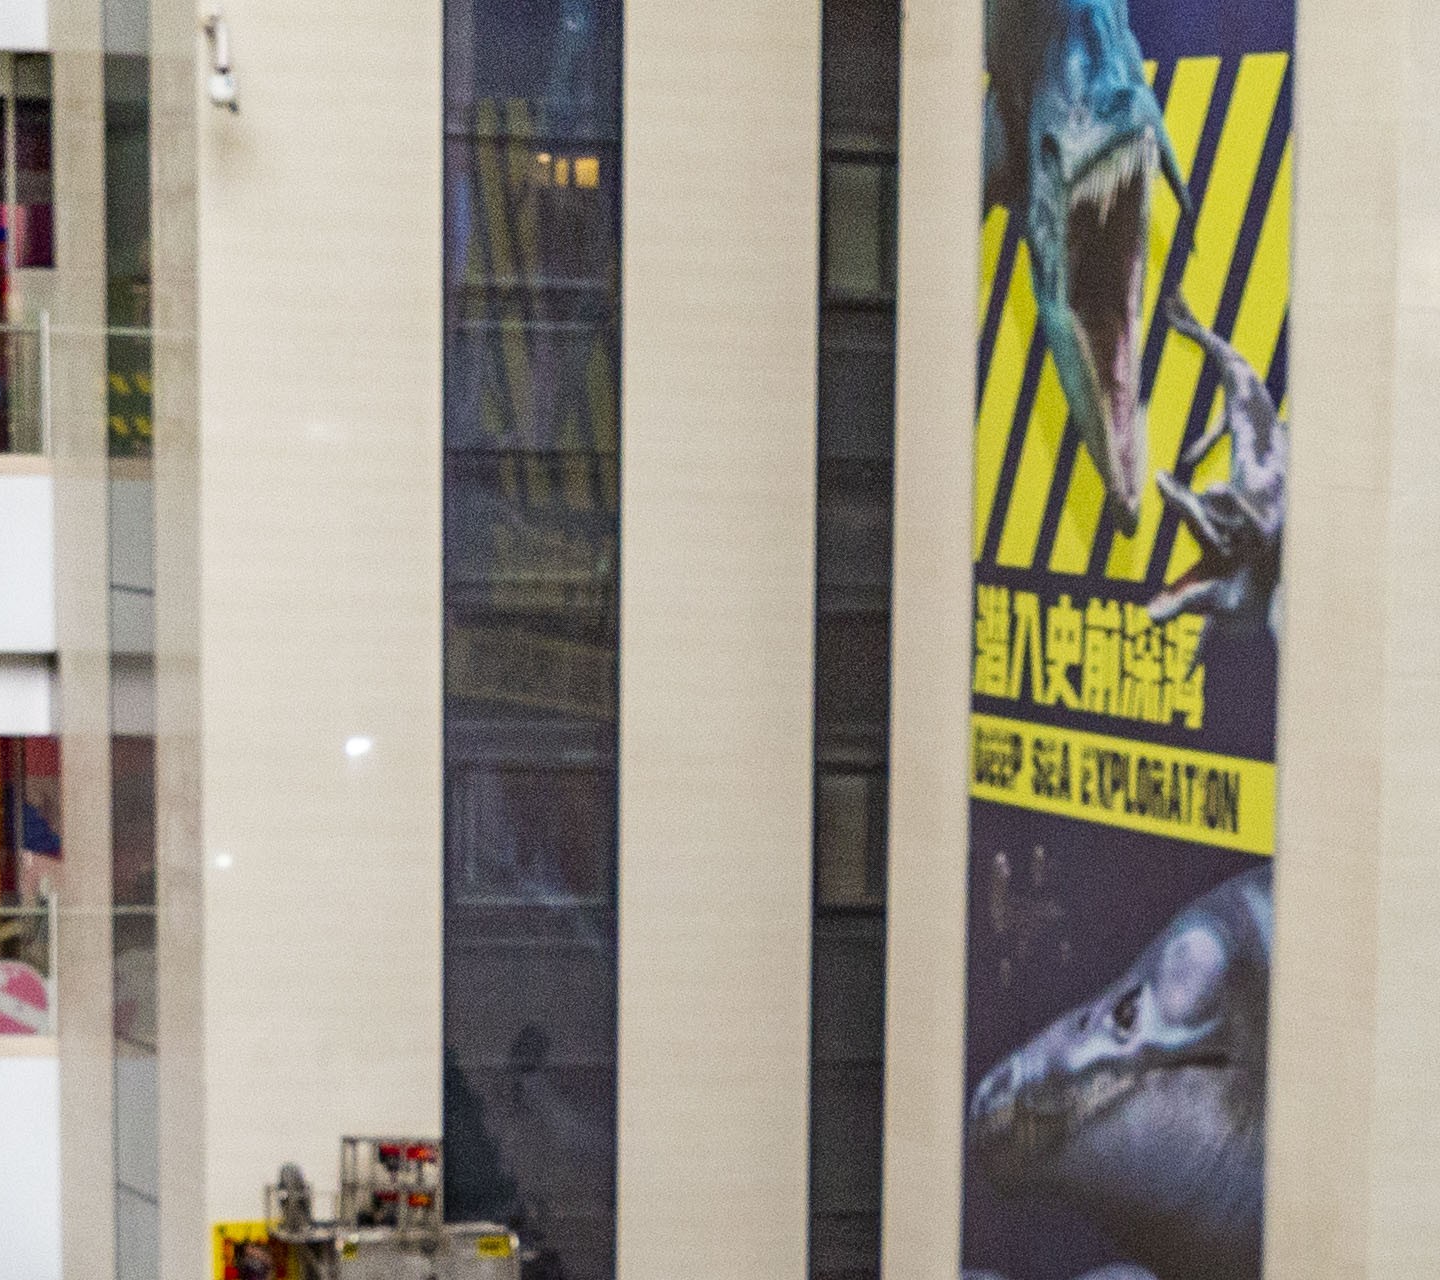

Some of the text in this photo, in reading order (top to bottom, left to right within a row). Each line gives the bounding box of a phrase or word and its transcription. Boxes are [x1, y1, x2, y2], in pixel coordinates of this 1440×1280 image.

[974, 726, 1242, 835] DEEP SEA EXPLORATION
